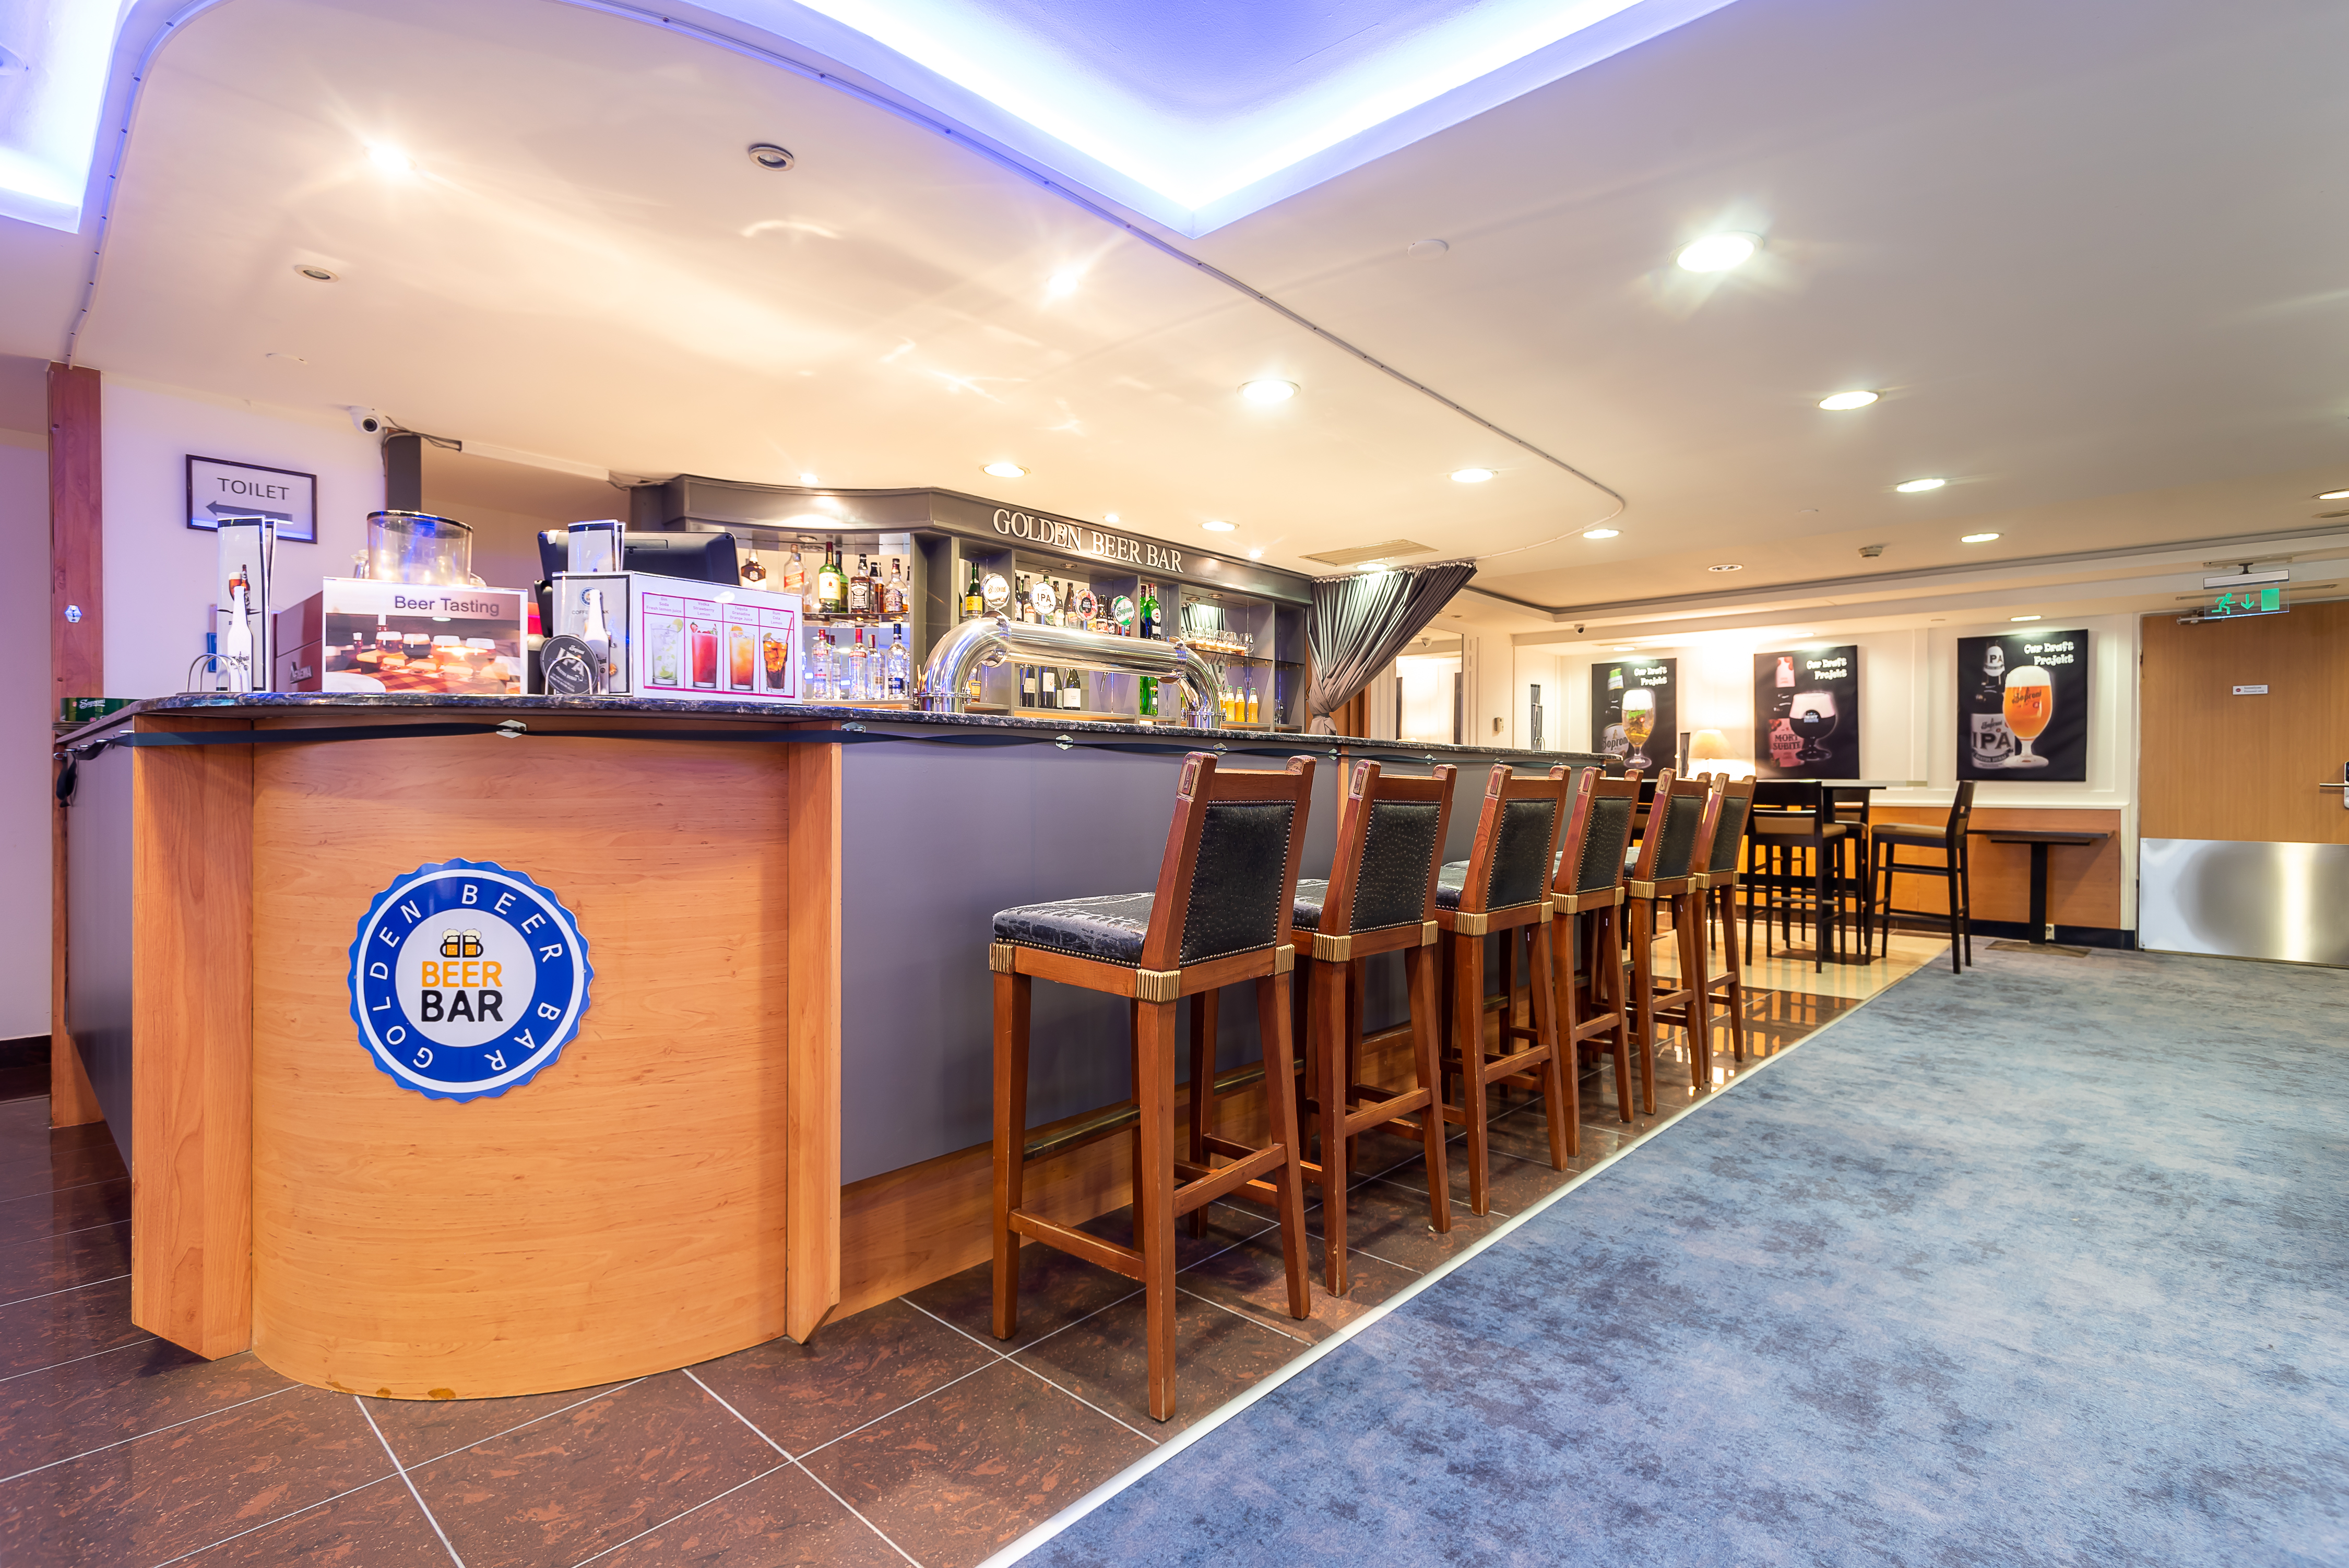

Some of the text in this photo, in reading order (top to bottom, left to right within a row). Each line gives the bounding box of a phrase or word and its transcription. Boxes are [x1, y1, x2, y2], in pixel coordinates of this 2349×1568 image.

[217, 477, 290, 500] TOILET
[993, 508, 1184, 573] GOLDEN BEER BAR
[1037, 593, 1051, 603] IPA
[395, 596, 499, 617] Beer Tasting
[1117, 606, 1133, 617] Soproni
[2024, 641, 2074, 654] Our Draft
[555, 647, 585, 676] IPA
[1806, 657, 1847, 670] Our Draft
[2033, 654, 2074, 666] Projekt
[1634, 666, 1668, 676] Our Draft
[1814, 669, 1847, 680] Projekt
[1640, 676, 1668, 686] Projekt
[79, 698, 105, 709] Soproni
[1774, 733, 1799, 742] MORT
[1972, 731, 2012, 750] IPA
[370, 884, 563, 1071] GOLDEN BEER BAR
[421, 961, 503, 988] BEER
[421, 990, 504, 1023] BAR
